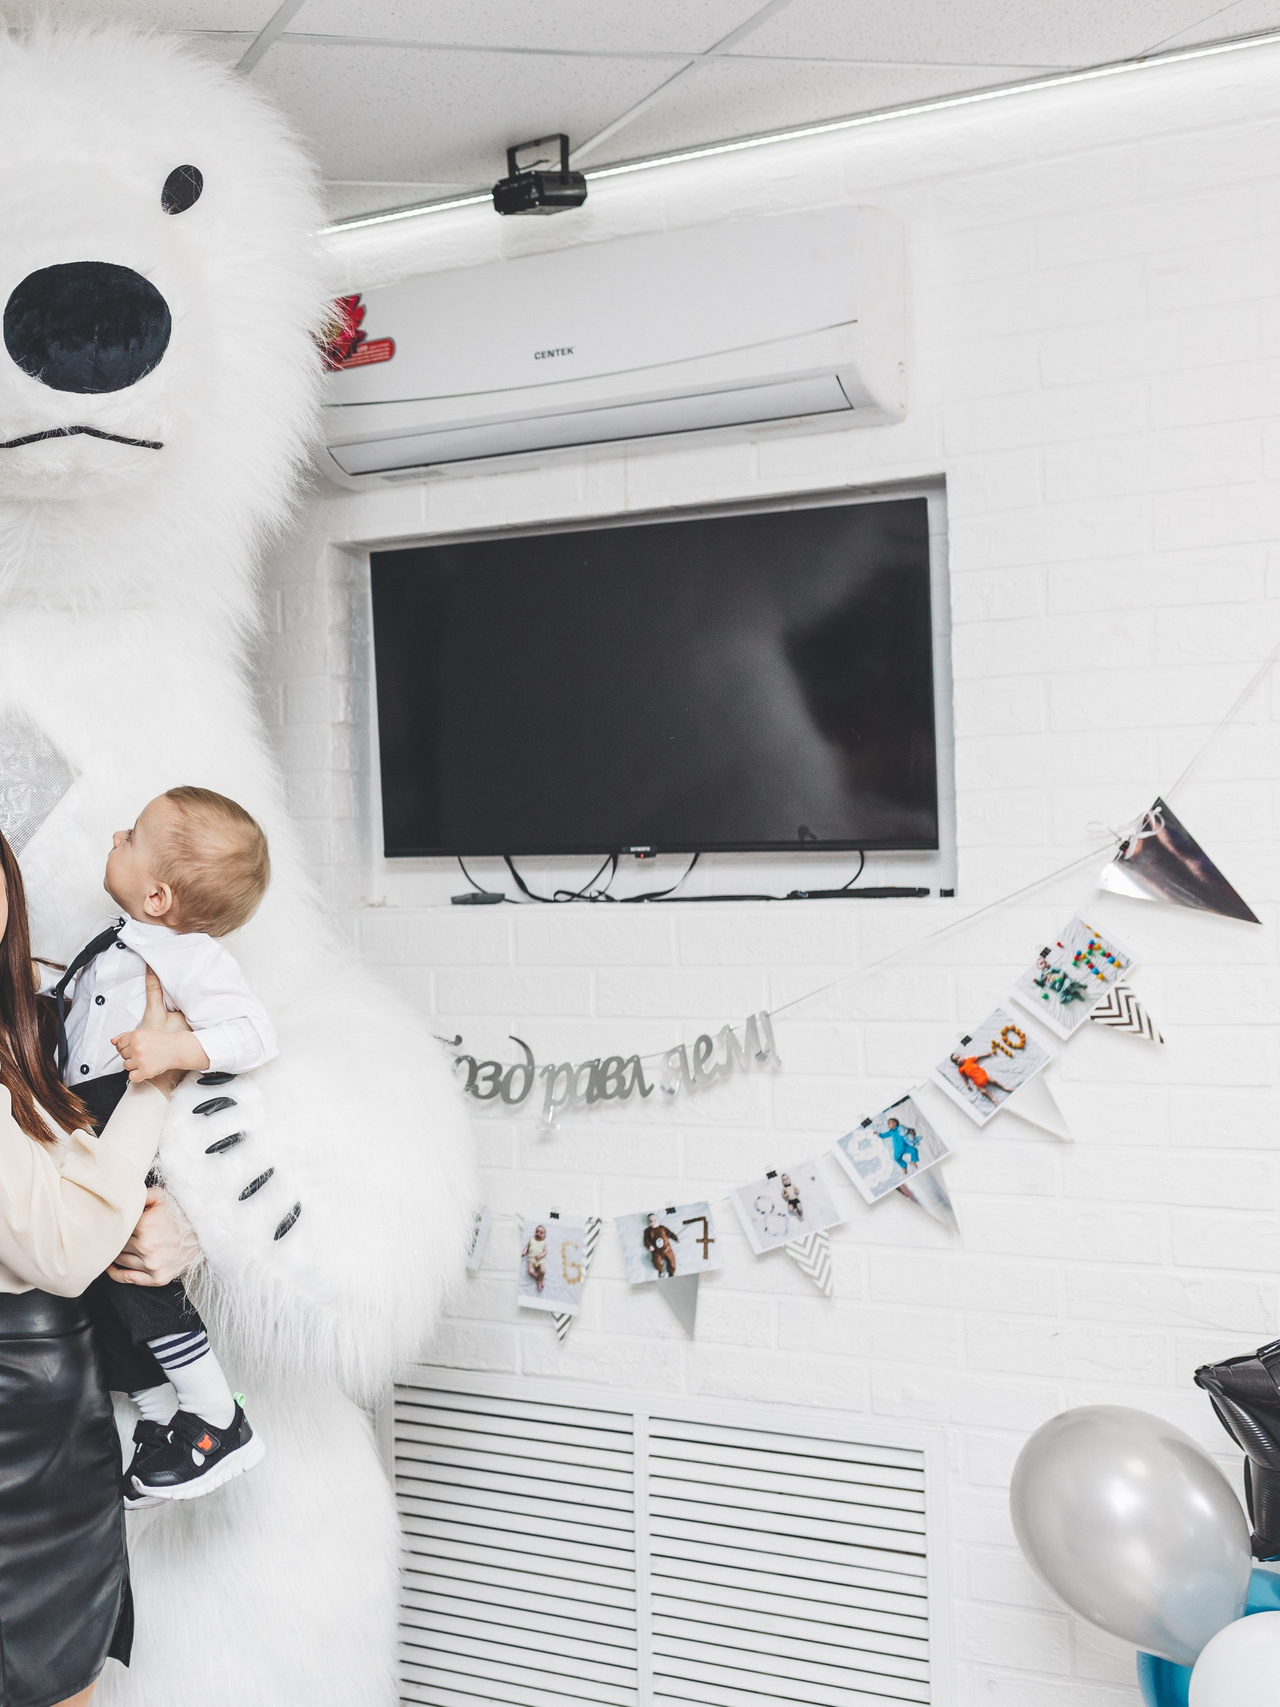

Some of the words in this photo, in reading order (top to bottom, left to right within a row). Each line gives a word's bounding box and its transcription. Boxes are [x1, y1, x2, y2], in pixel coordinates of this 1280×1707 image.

[534, 346, 575, 360] CENTEK
[991, 1024, 1026, 1058] 10
[432, 1010, 782, 1130] оздравляем!
[682, 1216, 715, 1260] 7
